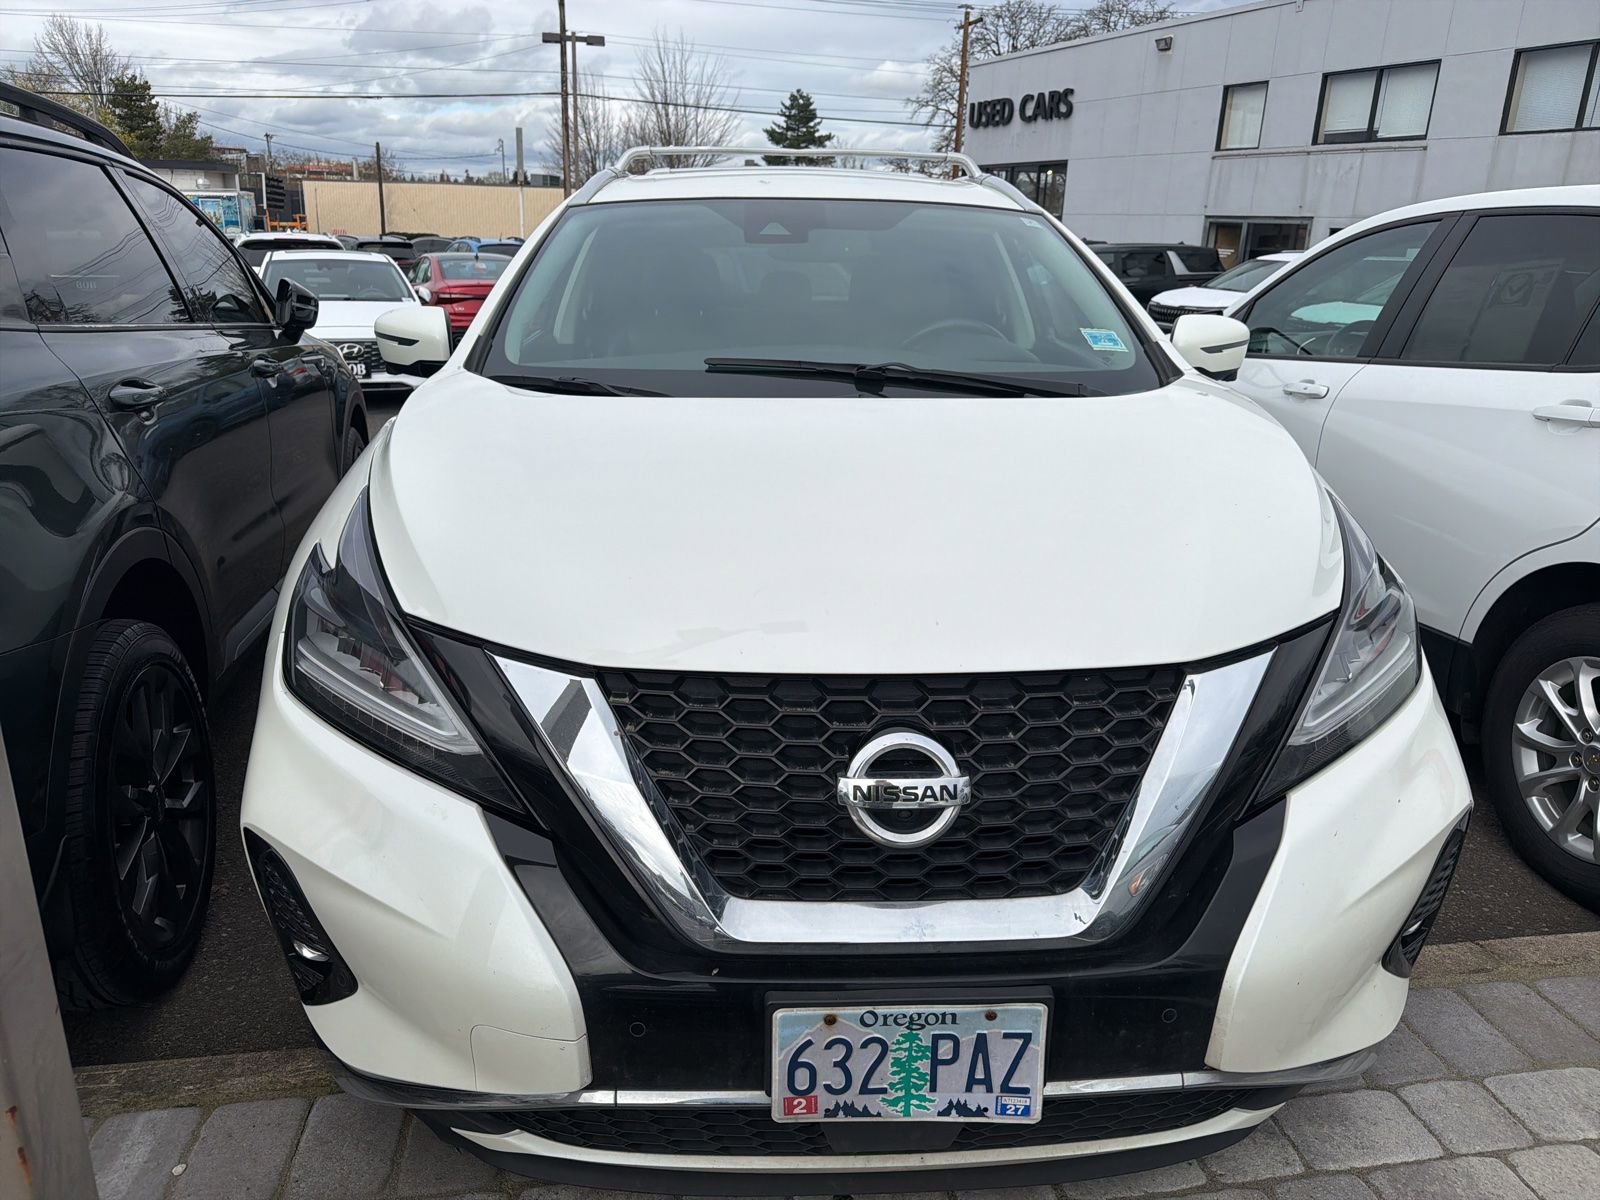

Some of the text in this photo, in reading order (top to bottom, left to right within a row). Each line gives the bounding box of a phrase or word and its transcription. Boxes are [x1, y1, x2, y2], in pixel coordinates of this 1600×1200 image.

[969, 88, 1074, 128] USED CARS
[852, 784, 958, 802] NISSAN
[859, 1010, 959, 1031] Oregon
[787, 1031, 1032, 1096] 632 PAZ
[793, 1098, 807, 1114] 2
[1005, 1104, 1025, 1115] 27
